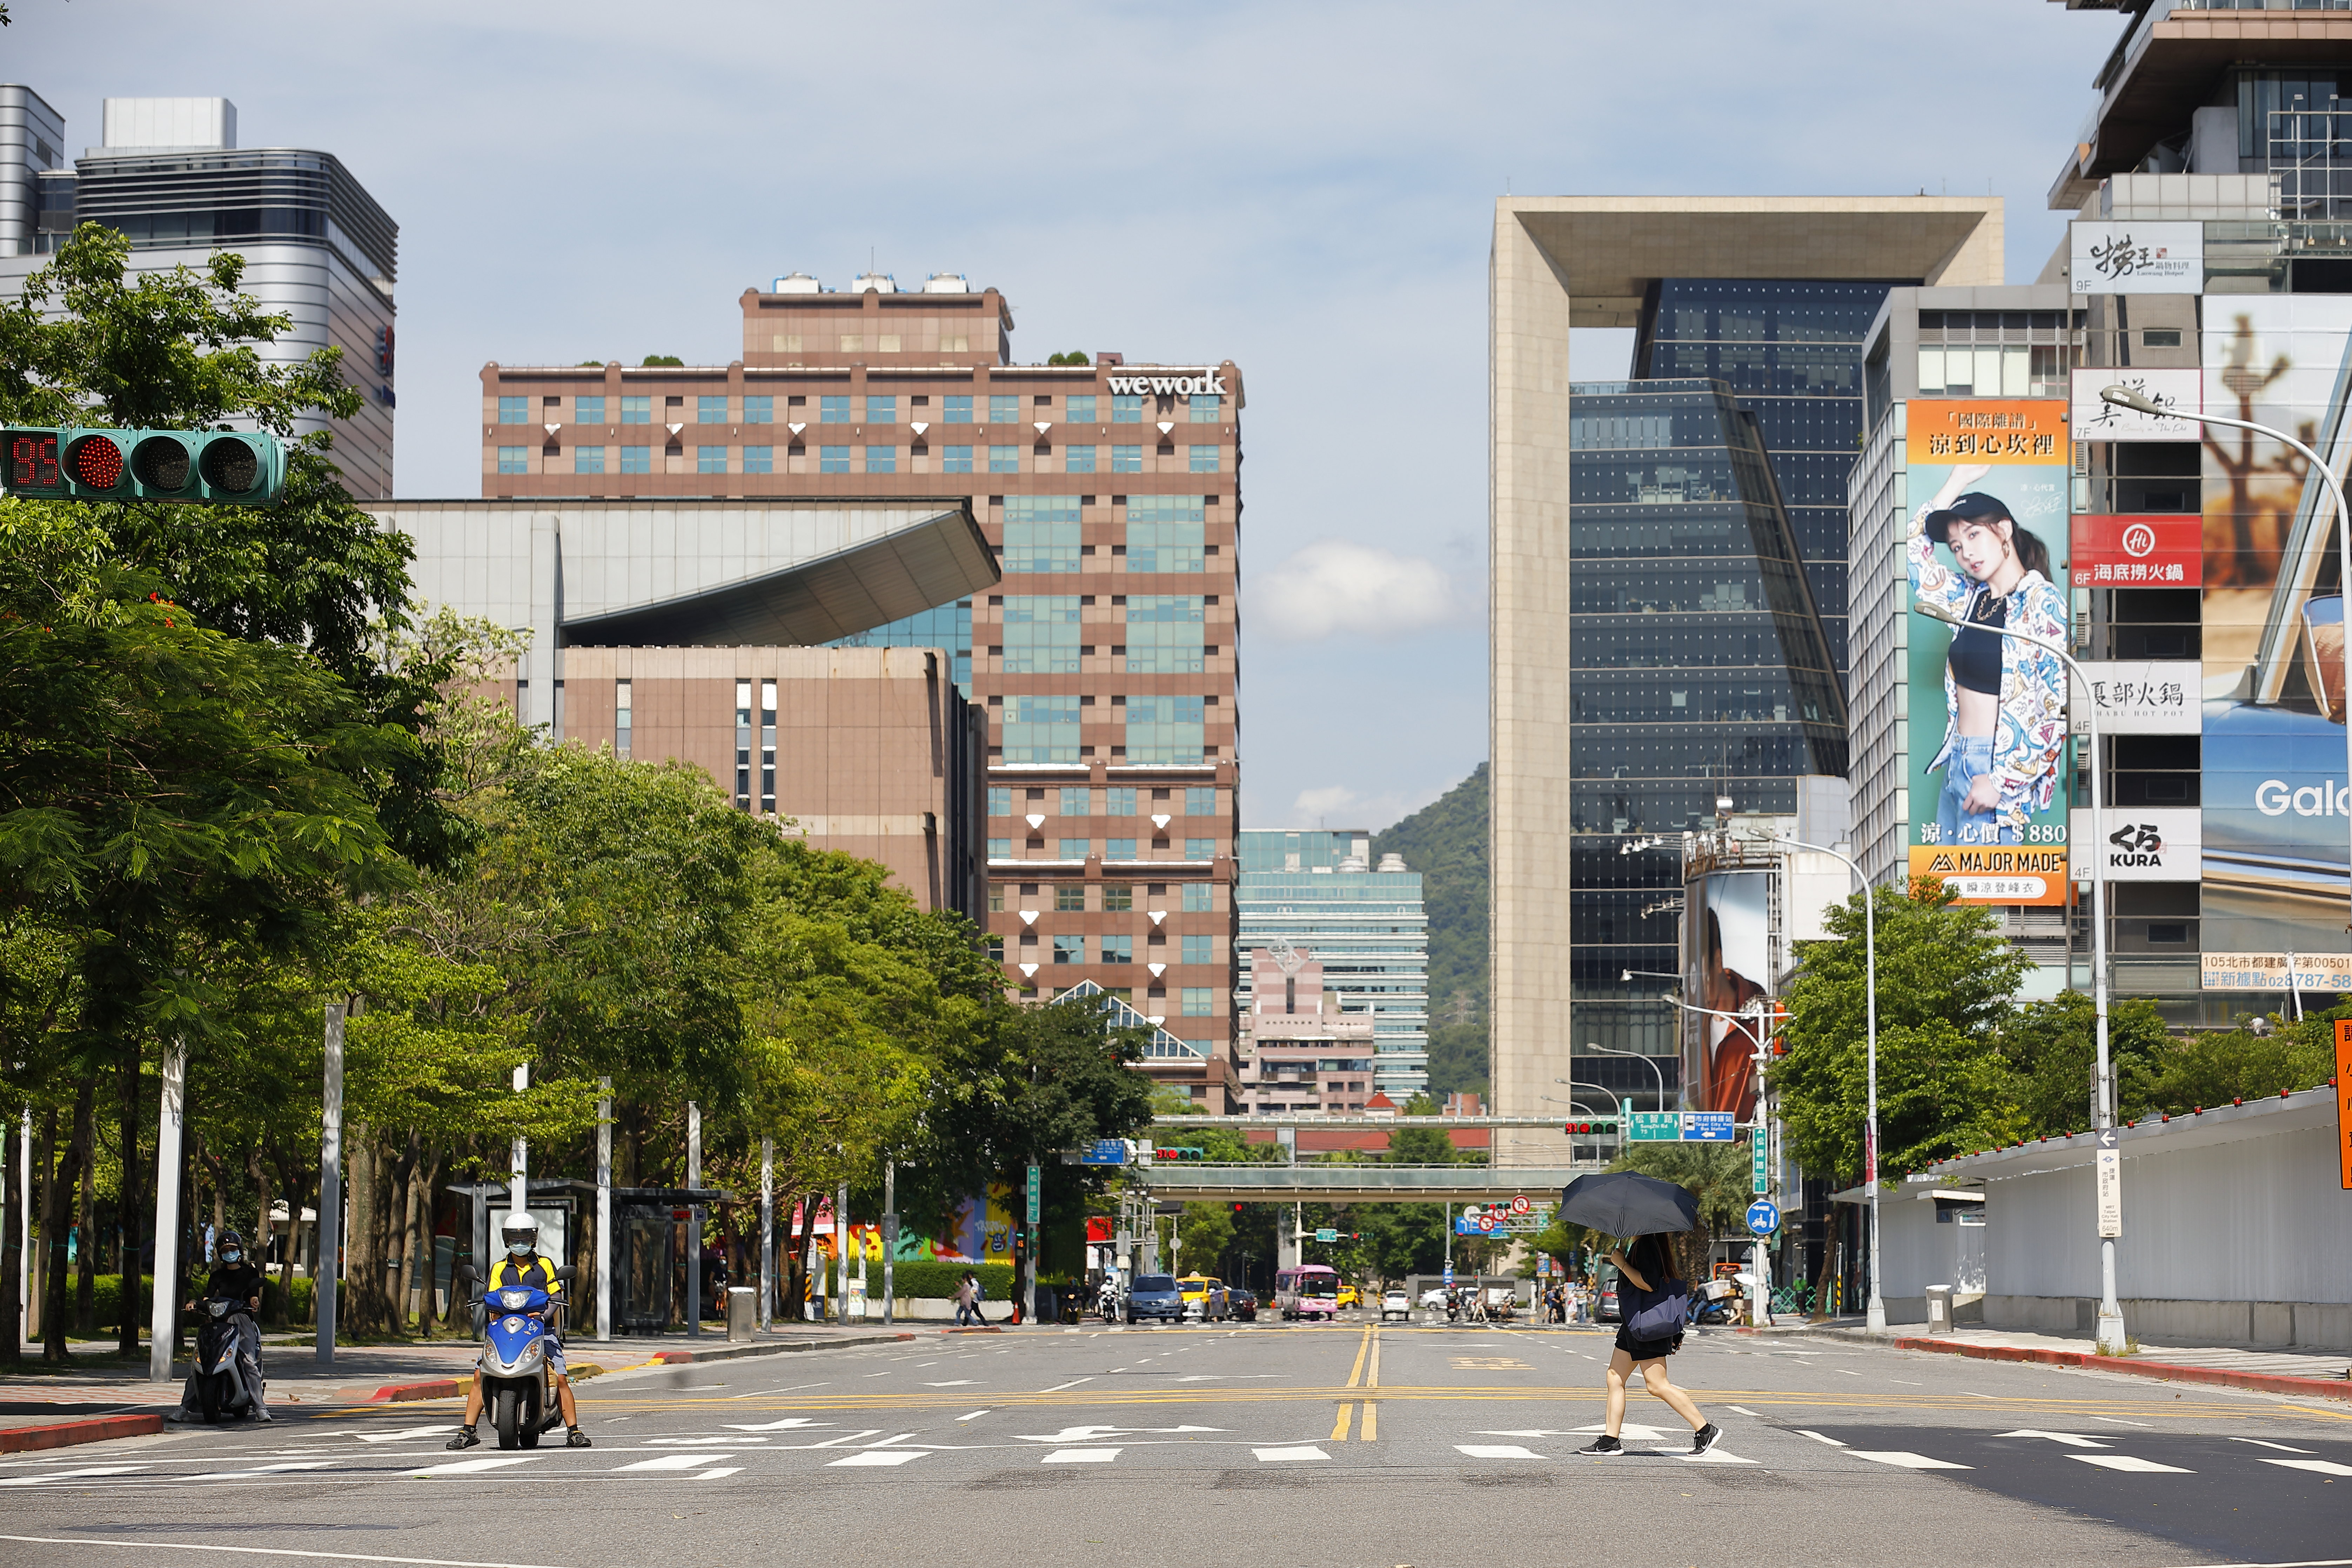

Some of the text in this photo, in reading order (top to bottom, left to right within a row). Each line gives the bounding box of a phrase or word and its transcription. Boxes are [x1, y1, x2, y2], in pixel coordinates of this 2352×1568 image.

[2076, 280, 2091, 291] 9F
[1106, 366, 1227, 395] wework
[2076, 427, 2091, 437] 7F
[1929, 433, 2054, 456] 涼到心坎裡
[13, 437, 57, 484] 95
[2130, 530, 2148, 549] Hi
[2075, 573, 2091, 584] 6F
[2094, 563, 2183, 581] 海底撈火鍋
[2075, 721, 2090, 731] 4F
[2110, 824, 2161, 852] くら
[1960, 852, 2061, 872] MAJOR MADE
[2110, 854, 2162, 866] KURA
[2075, 867, 2090, 878] 4F
[1566, 1123, 1577, 1133] 97
